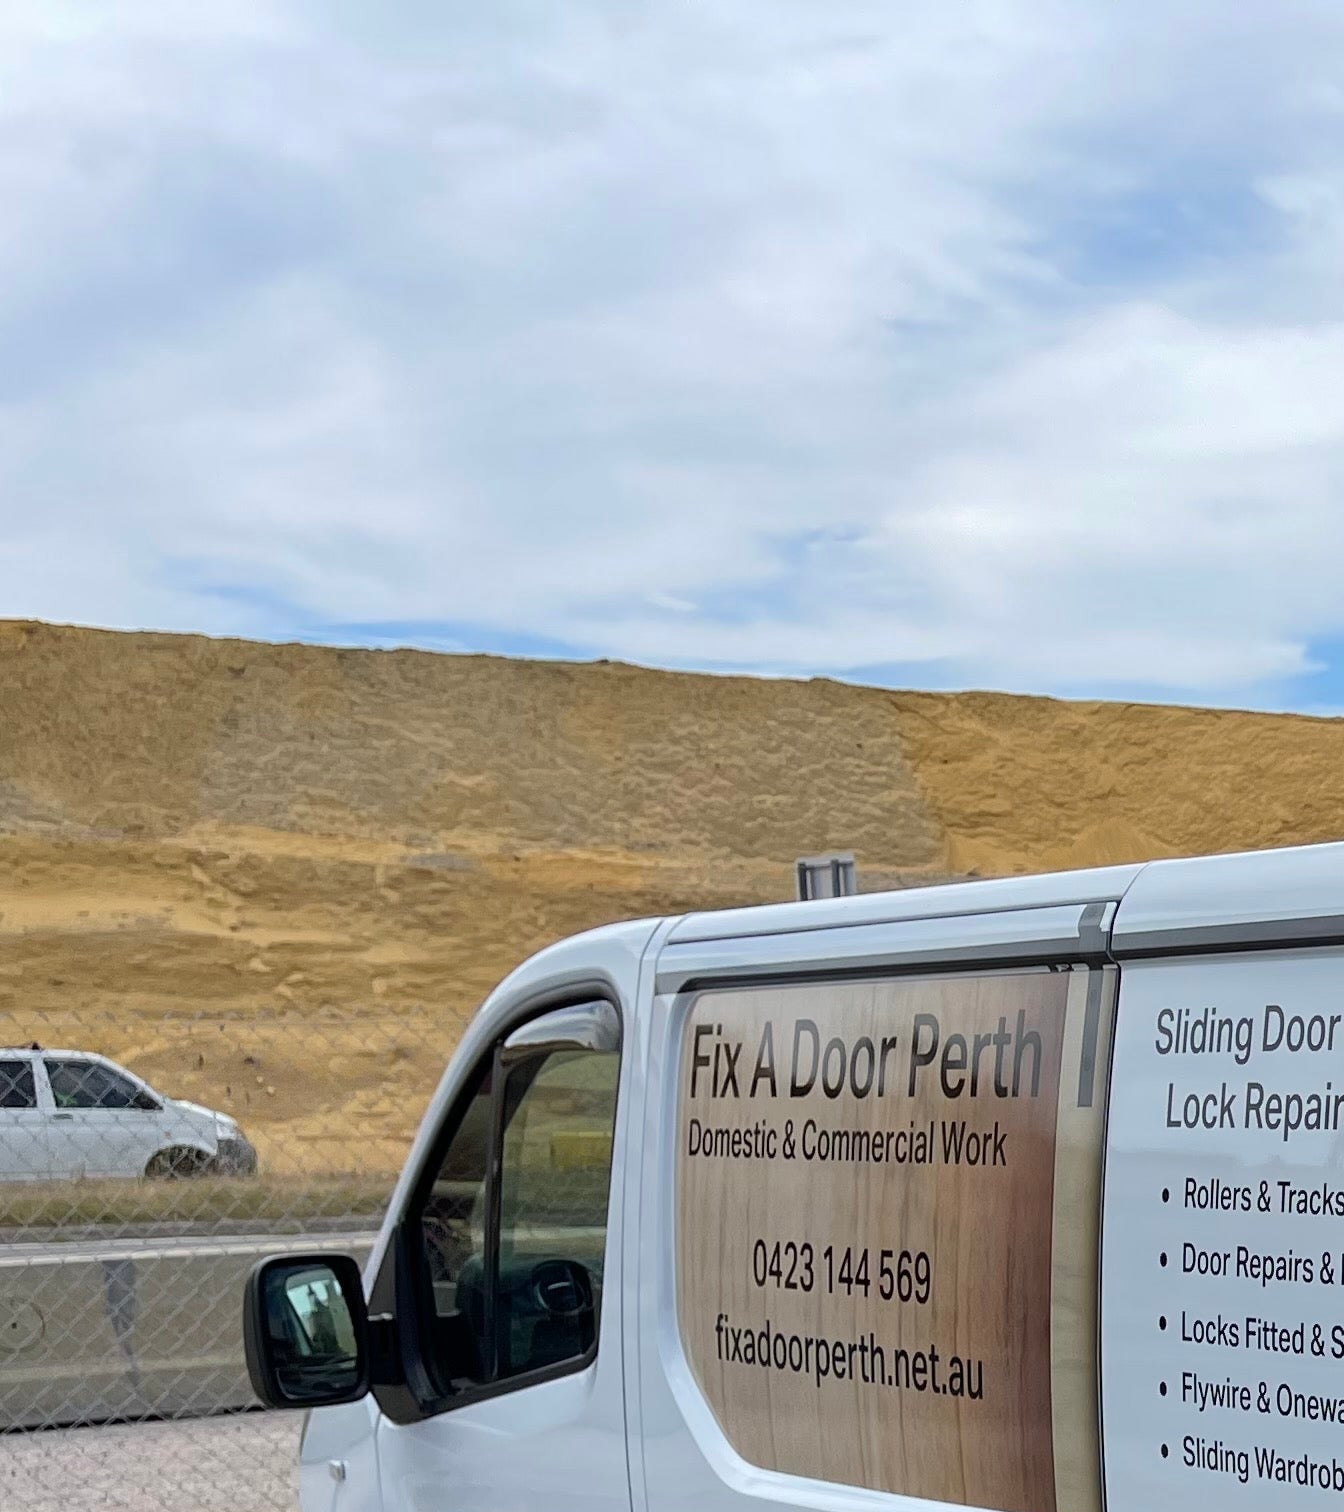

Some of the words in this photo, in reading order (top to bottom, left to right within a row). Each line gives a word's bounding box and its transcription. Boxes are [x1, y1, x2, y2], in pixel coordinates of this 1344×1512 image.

[690, 1022, 742, 1099] Fix
[750, 1020, 777, 1097] A
[790, 1017, 898, 1099] Door
[908, 1009, 1043, 1099] Perth
[1155, 1007, 1254, 1065] Sliding
[1262, 1005, 1341, 1053] Door
[1166, 1082, 1236, 1129] Lock
[689, 1118, 777, 1160] Domestic
[782, 1120, 796, 1160] &
[802, 1120, 935, 1164] Commercial
[941, 1121, 1007, 1167] Work
[1184, 1177, 1252, 1213] Rollers
[1257, 1180, 1271, 1214] &
[754, 1239, 814, 1292] 0423
[823, 1246, 870, 1298] 144
[879, 1250, 931, 1304] 569
[1182, 1242, 1231, 1277] Door
[1236, 1246, 1314, 1288] Repairs
[1319, 1252, 1335, 1286] &
[716, 1314, 984, 1400] fixadoorperth.net.au
[1181, 1311, 1239, 1348] Locks
[1245, 1317, 1304, 1354] Fitted
[1310, 1323, 1326, 1357] &
[1181, 1372, 1251, 1412] Flywire
[1256, 1381, 1271, 1414] &
[1183, 1435, 1249, 1483] Sliding
